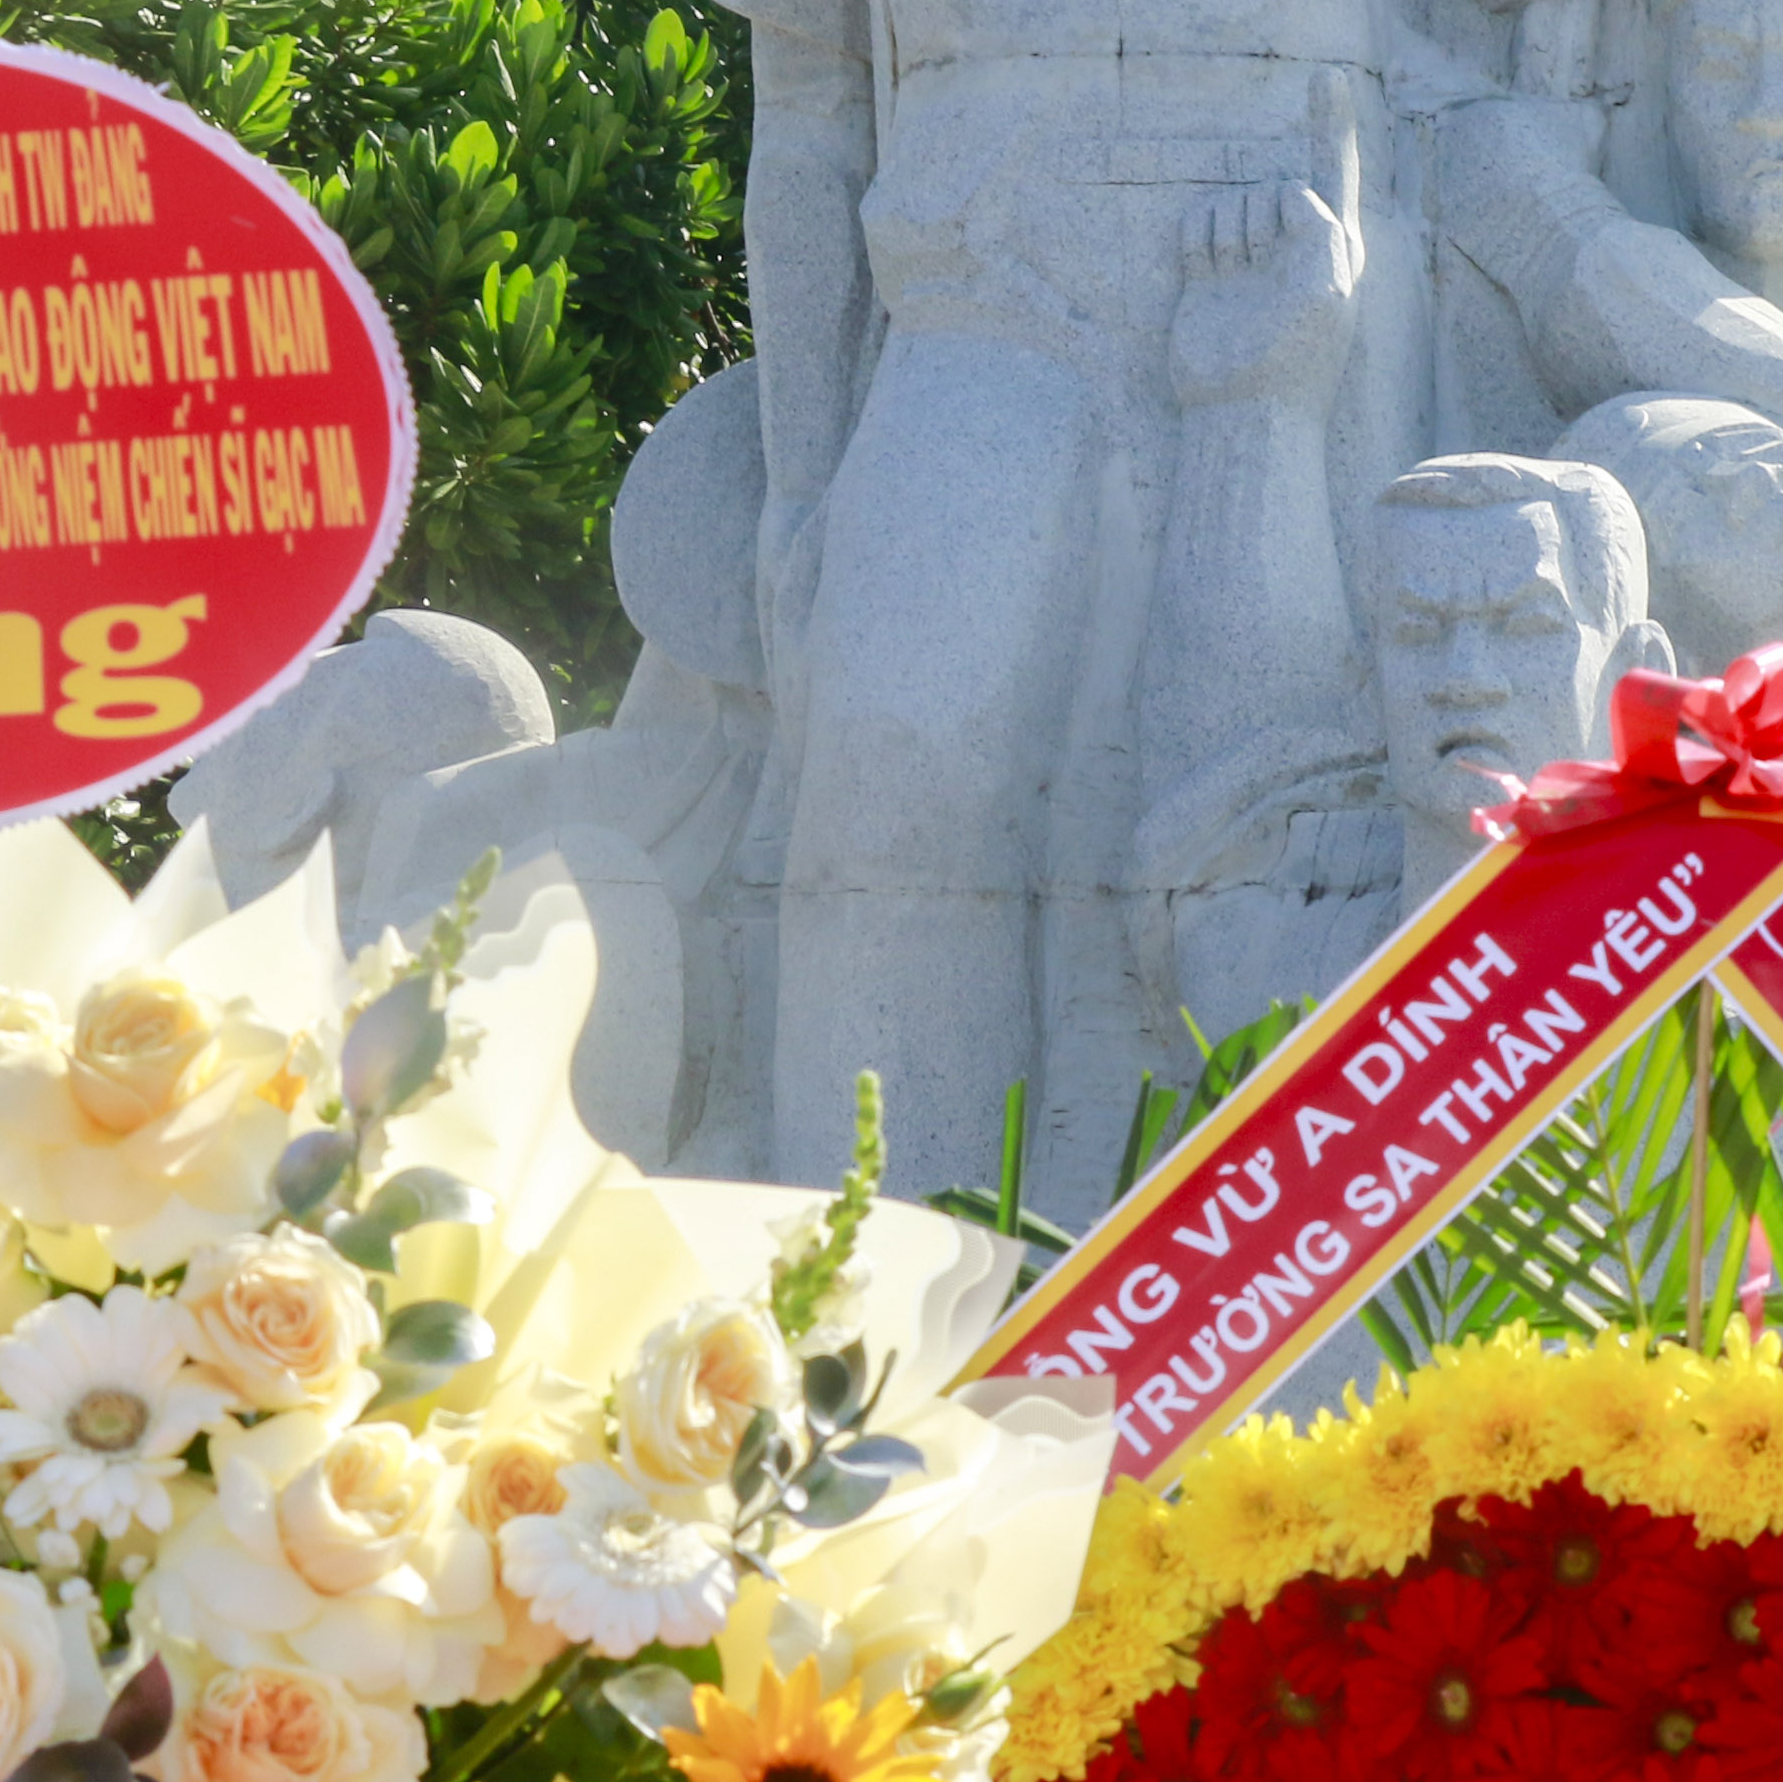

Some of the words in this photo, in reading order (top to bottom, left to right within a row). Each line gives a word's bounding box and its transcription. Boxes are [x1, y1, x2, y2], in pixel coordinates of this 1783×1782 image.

[17, 129, 68, 231] TW
[69, 88, 155, 228] ĐẢNG
[44, 254, 154, 412] ĐỘNG
[151, 246, 237, 404] VIỆT
[243, 268, 331, 376] NAM
[50, 413, 129, 567] NIỆM
[129, 392, 220, 543] CHIẾN
[219, 405, 254, 536] SĨ
[254, 426, 315, 554] GẠC
[313, 424, 367, 529] MA
[1172, 1149, 1281, 1258] VỪ
[1294, 1105, 1356, 1168] A
[1342, 931, 1518, 1106] DÍNH
[1111, 1219, 1352, 1457] TRƯỜNG
[1344, 1144, 1440, 1228] SA
[1418, 988, 1587, 1144] THÂN
